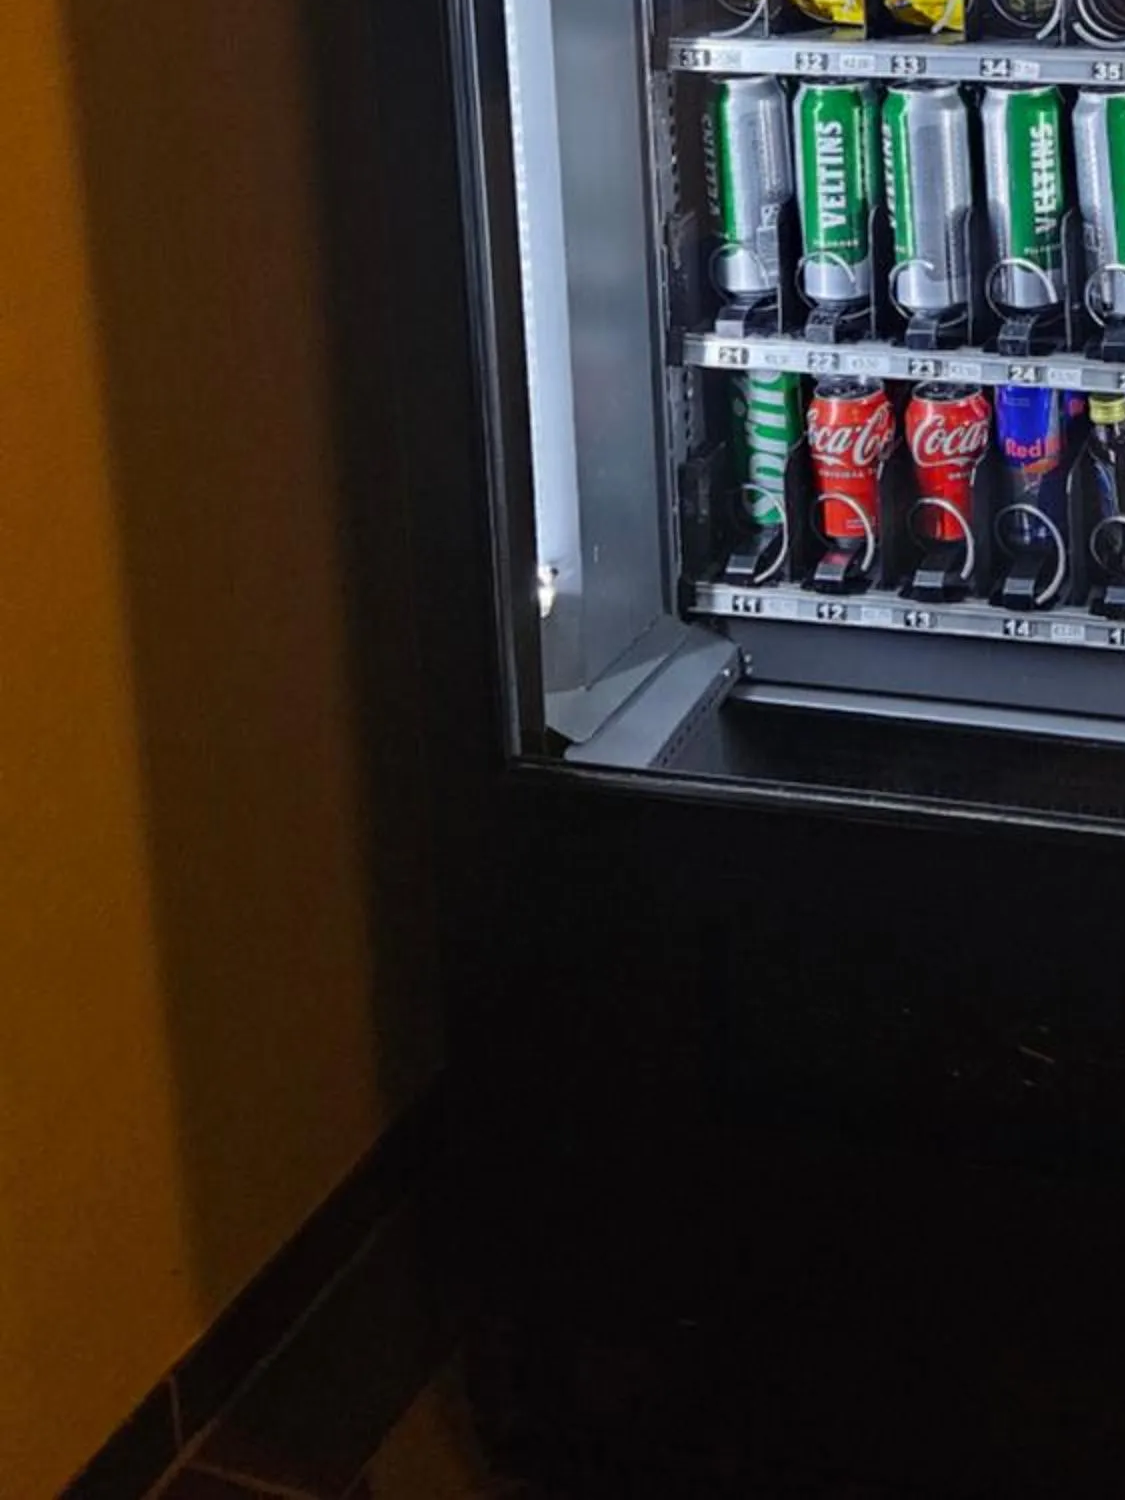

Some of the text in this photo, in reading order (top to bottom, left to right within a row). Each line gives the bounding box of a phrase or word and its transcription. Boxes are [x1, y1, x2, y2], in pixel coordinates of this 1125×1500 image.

[894, 56, 919, 74] 33
[982, 58, 1007, 76] 34
[1095, 63, 1121, 80] 35
[816, 120, 847, 229] VELTINS
[1029, 122, 1057, 235] VELTINS
[911, 360, 936, 377] 23
[1010, 366, 1036, 382] 24
[1005, 438, 1042, 457] Red
[735, 596, 758, 613] 11
[820, 604, 843, 621] 12
[907, 612, 931, 627] 13
[1005, 620, 1030, 637] 14
